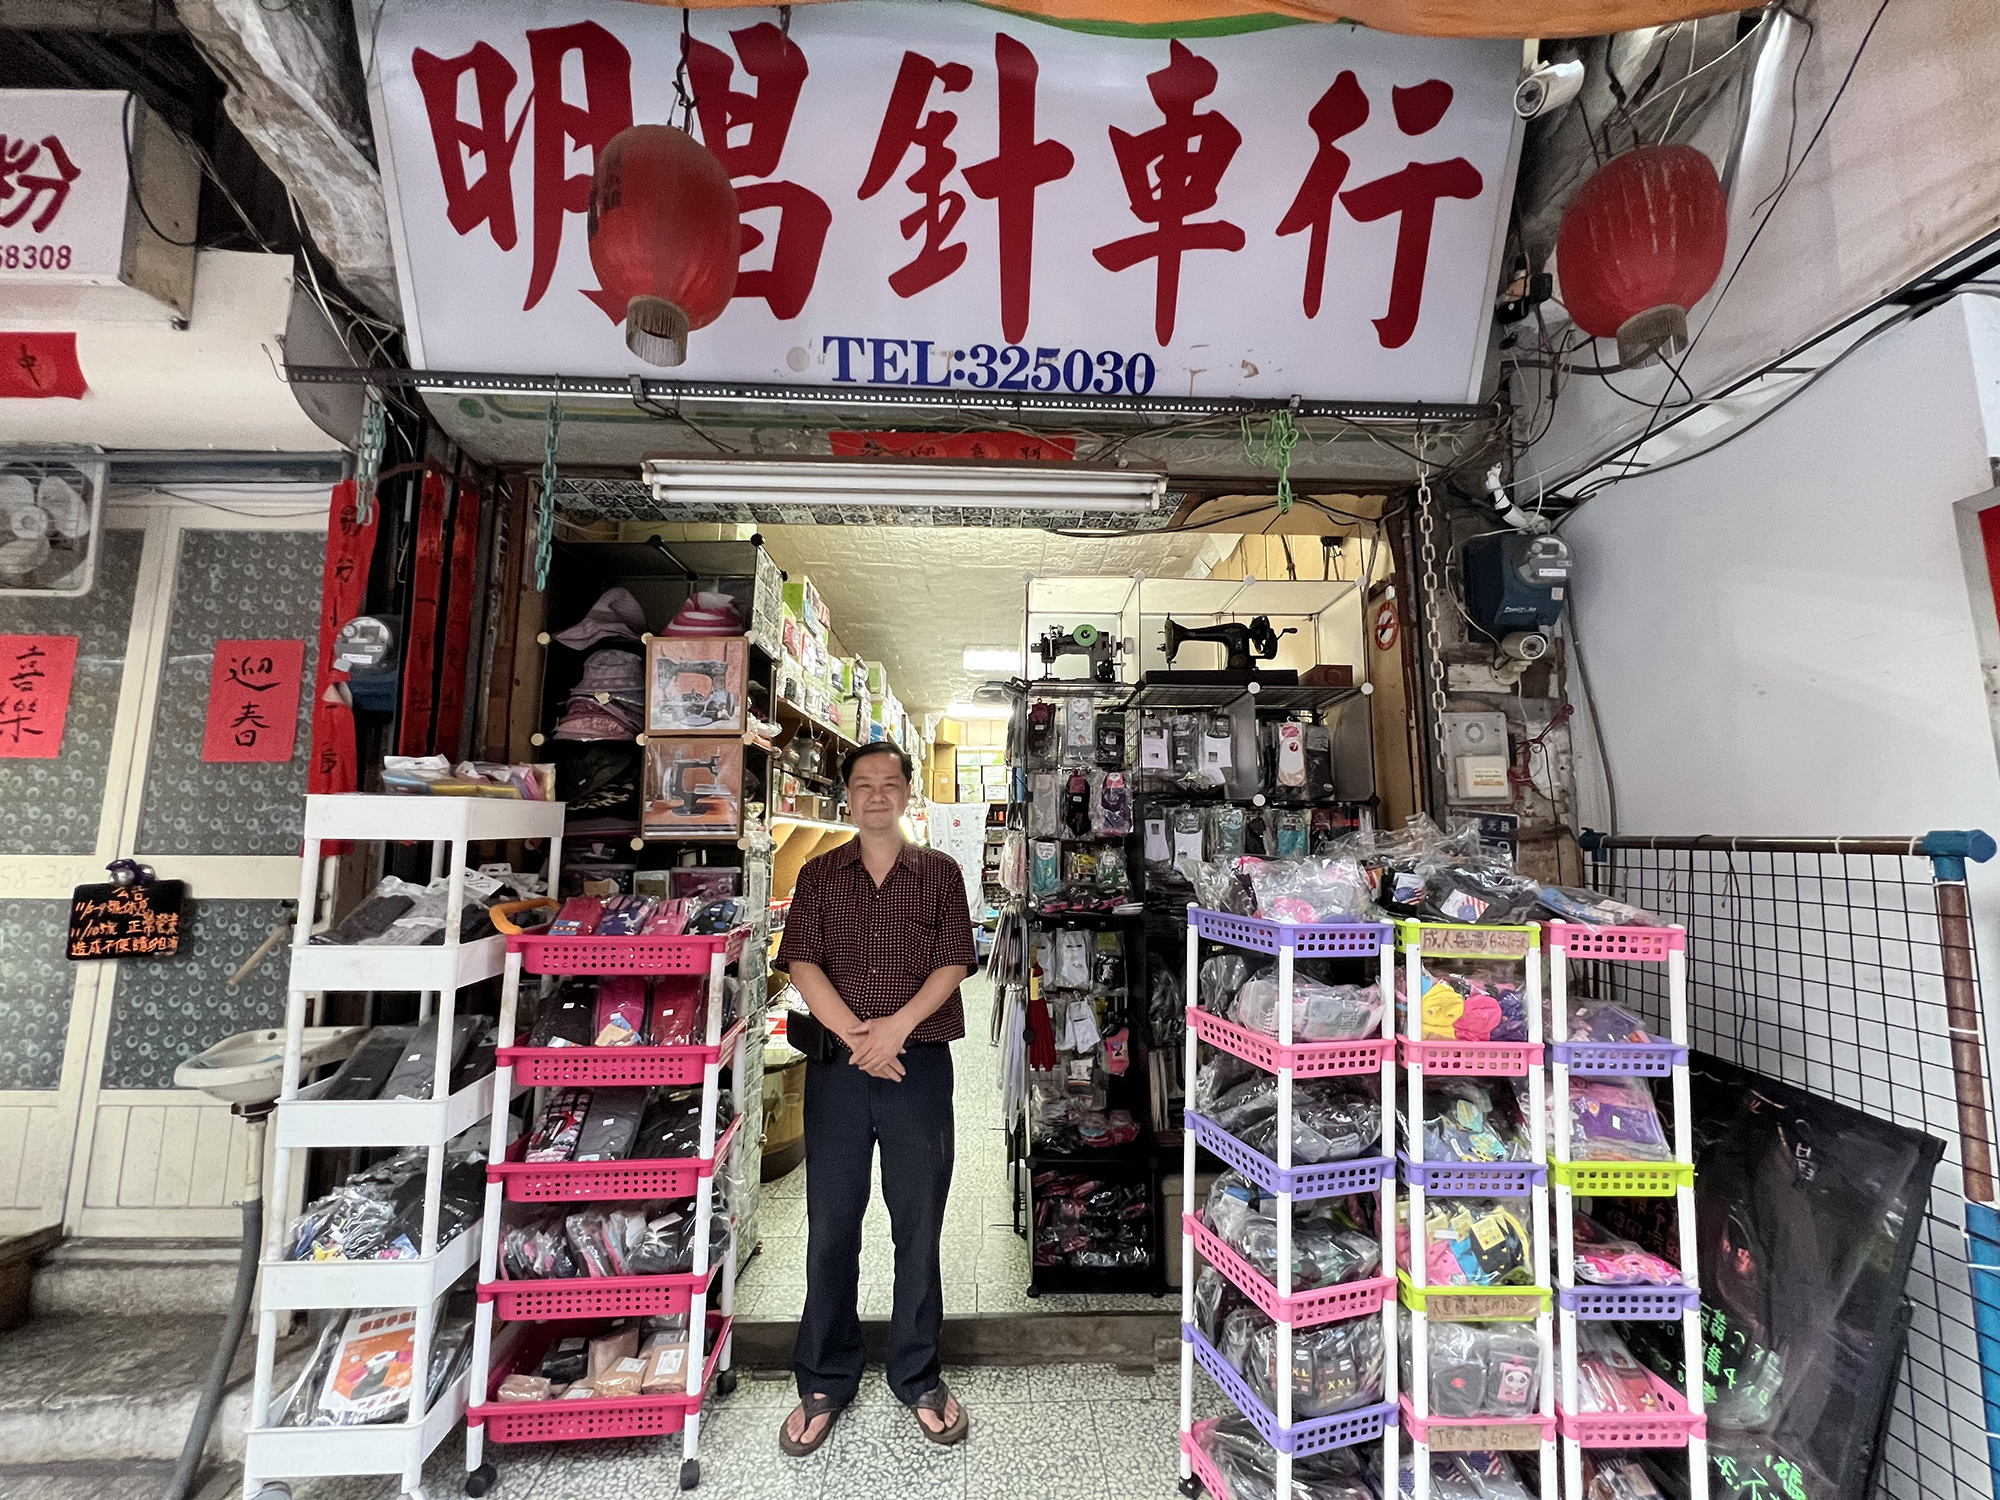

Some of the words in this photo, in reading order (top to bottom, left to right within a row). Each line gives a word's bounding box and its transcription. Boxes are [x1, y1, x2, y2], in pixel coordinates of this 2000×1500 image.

[411, 20, 1484, 348] 明昌針車行
[0, 245, 72, 270] 8308
[823, 335, 1156, 397] TEL:325030
[225, 655, 282, 748] 迎春
